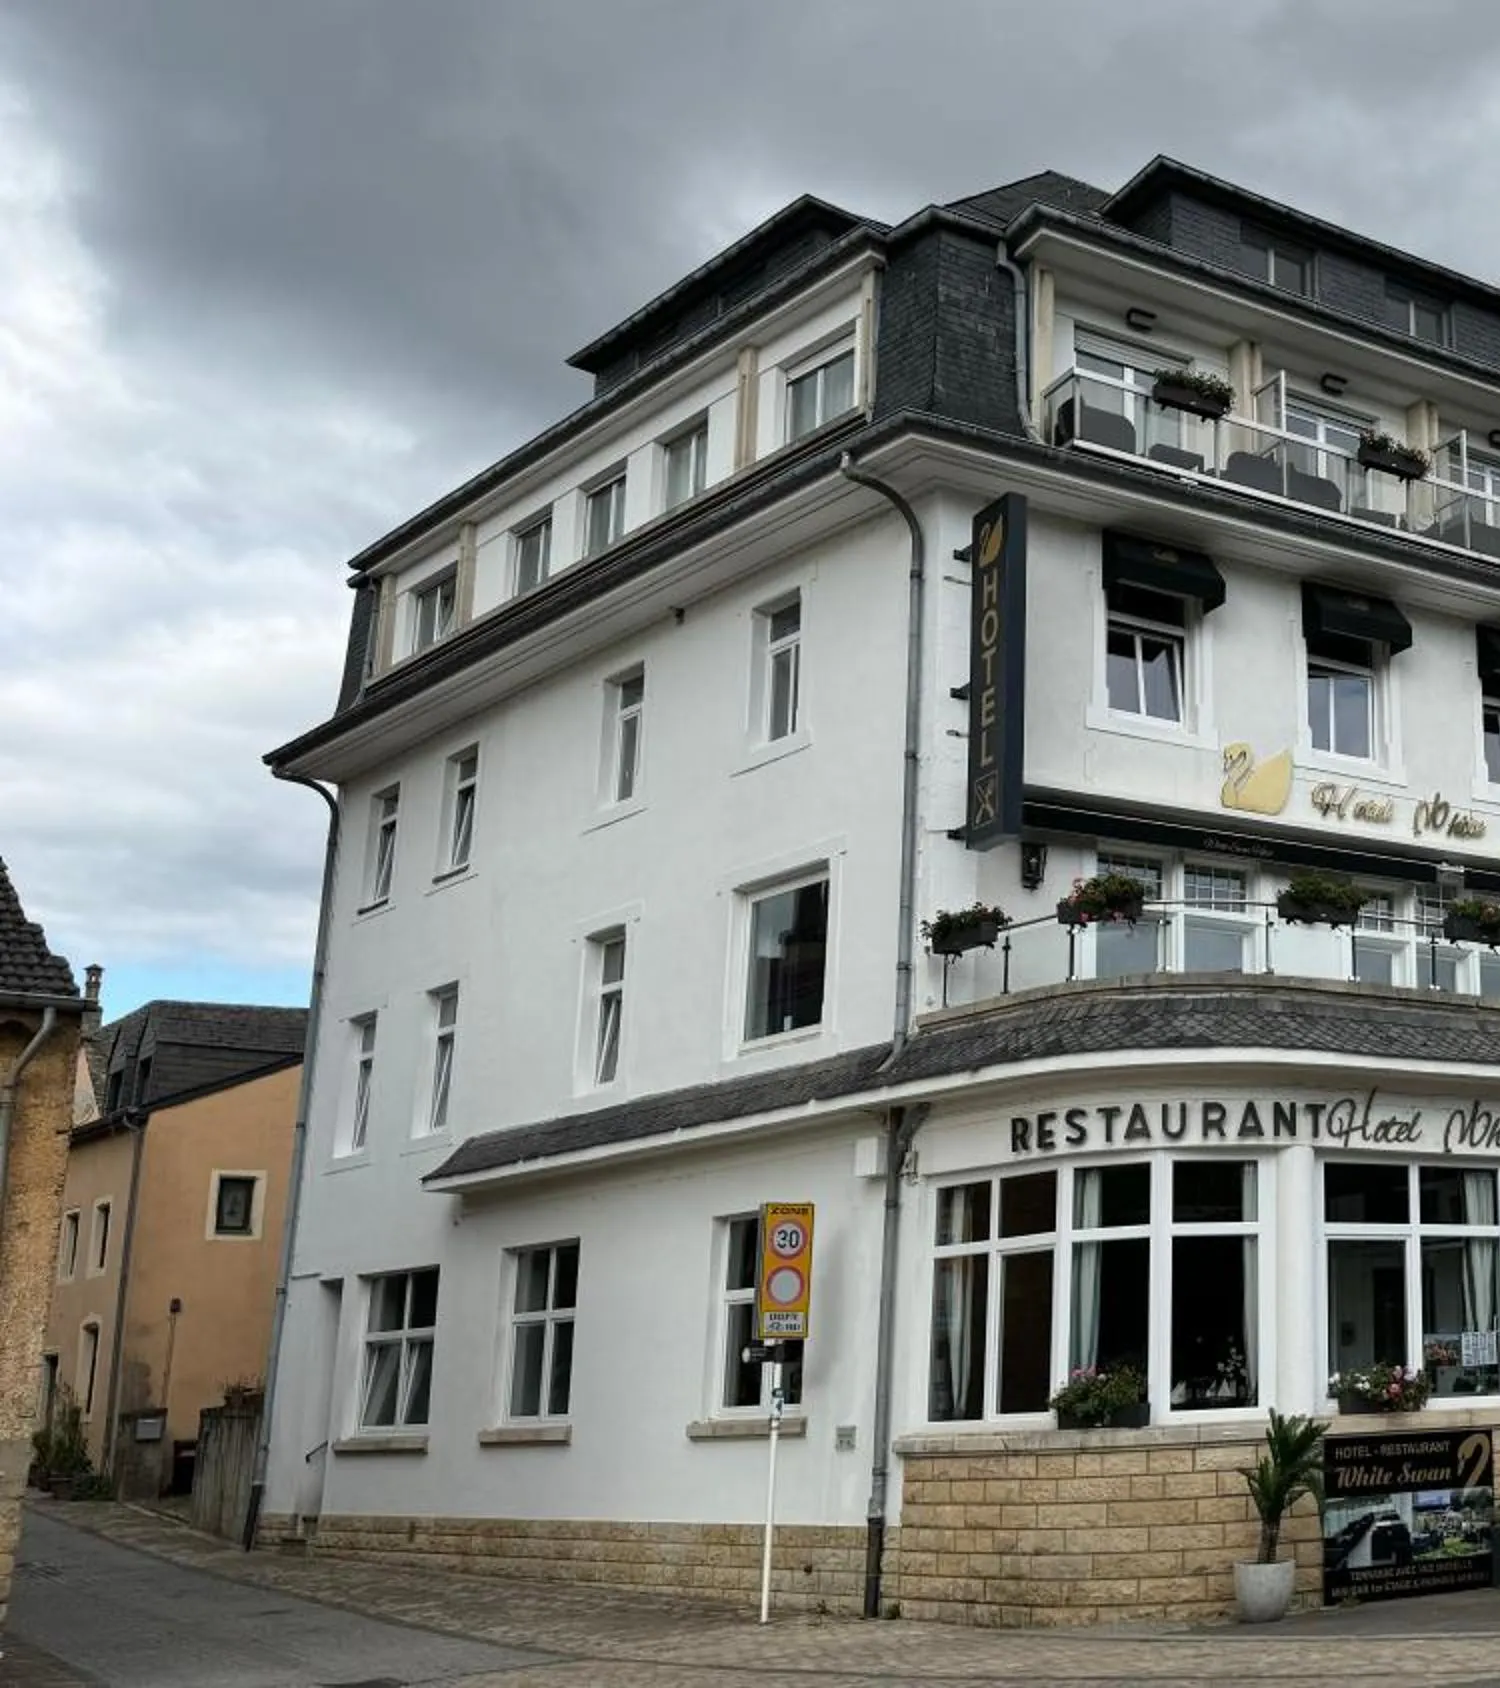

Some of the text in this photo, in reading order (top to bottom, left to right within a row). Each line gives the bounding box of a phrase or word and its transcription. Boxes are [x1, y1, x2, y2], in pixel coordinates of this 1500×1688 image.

[980, 567, 998, 768] HOTEL
[1010, 1101, 1327, 1151] RESTAURANT
[1326, 1086, 1422, 1147] Hotel
[776, 1229, 800, 1249] 30
[1335, 1444, 1373, 1460] HOTEL
[1335, 1461, 1452, 1489] White Swan
